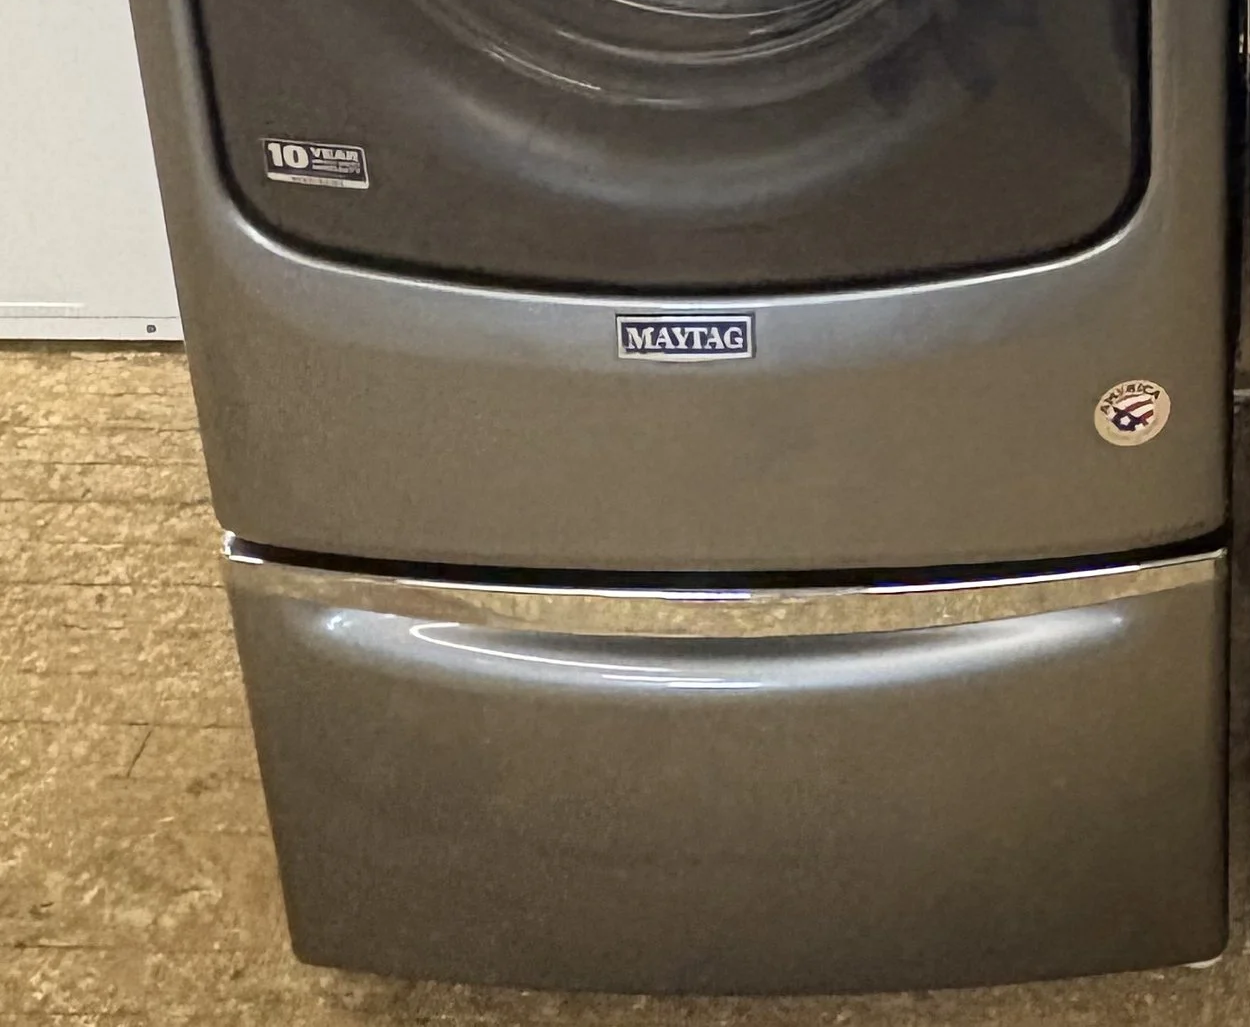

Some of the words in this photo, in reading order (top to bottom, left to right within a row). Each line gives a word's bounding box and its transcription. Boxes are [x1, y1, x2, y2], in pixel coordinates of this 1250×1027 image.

[267, 142, 309, 169] 10
[309, 146, 359, 162] YEAR
[625, 326, 744, 350] MAYTAG
